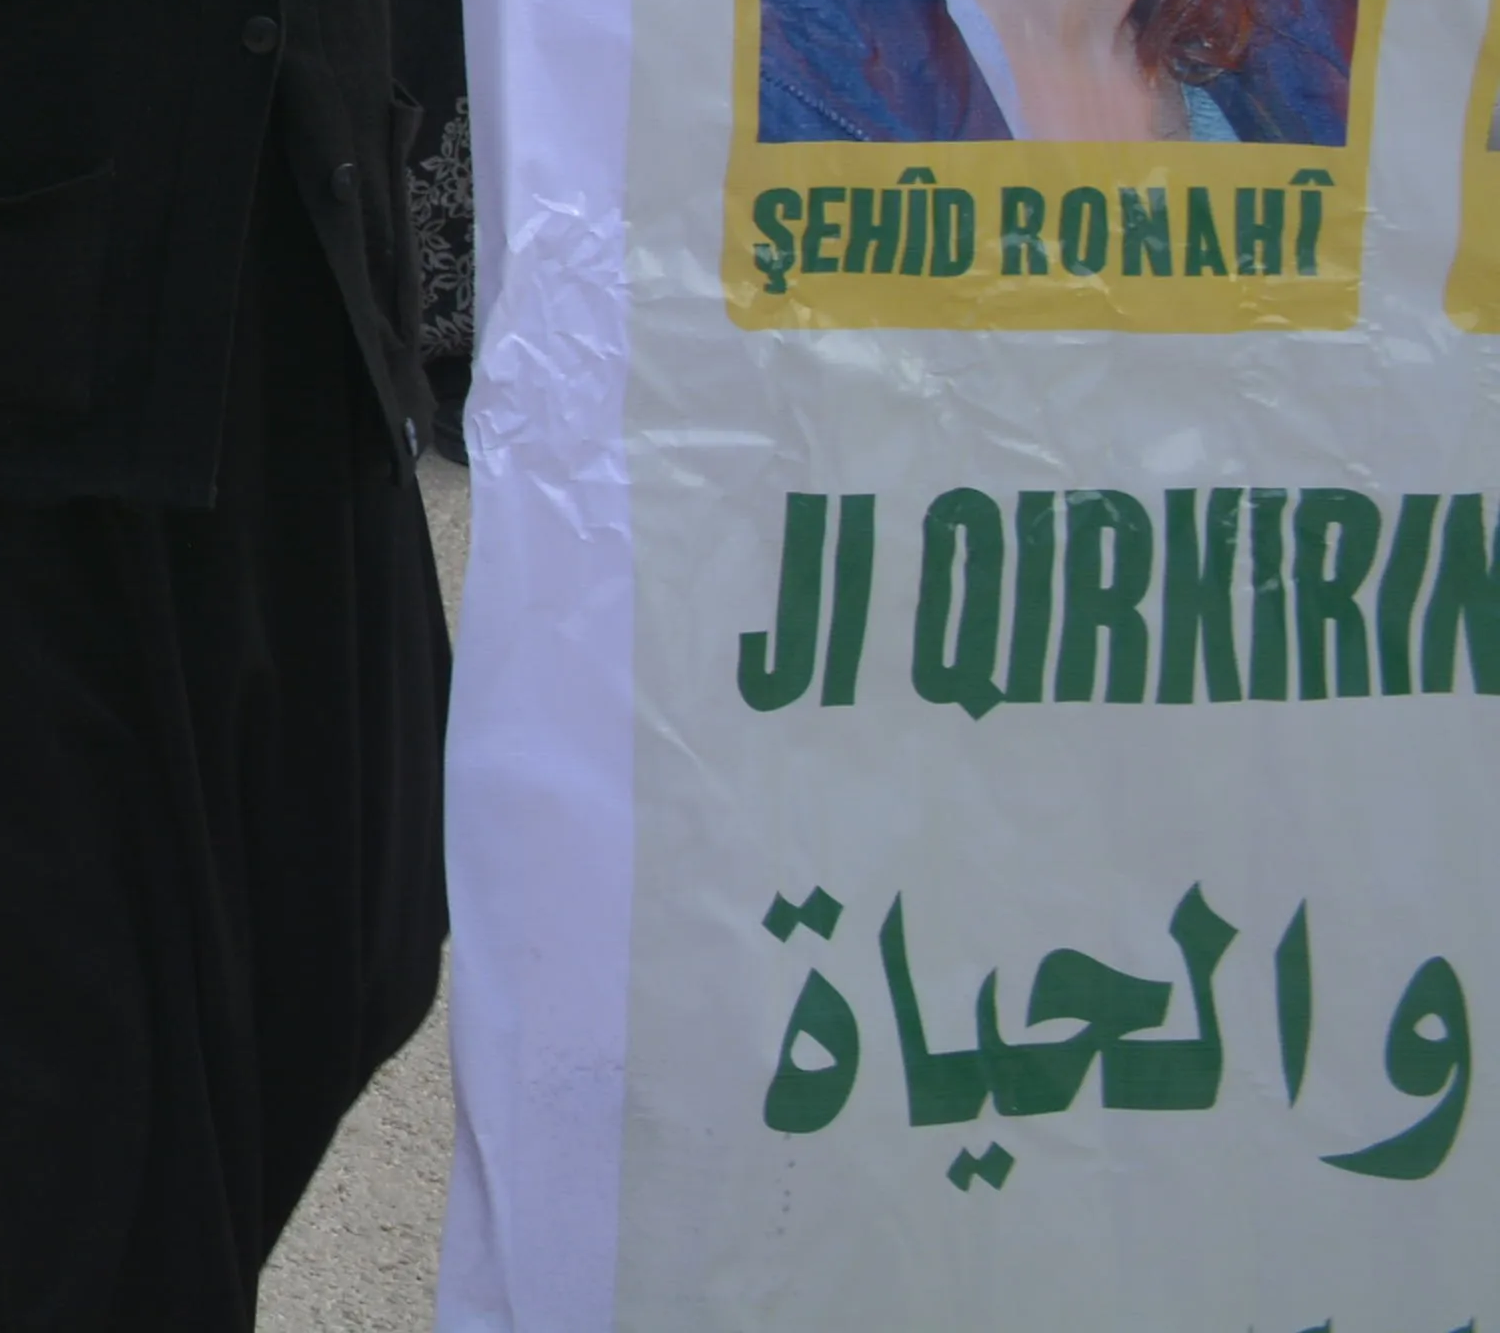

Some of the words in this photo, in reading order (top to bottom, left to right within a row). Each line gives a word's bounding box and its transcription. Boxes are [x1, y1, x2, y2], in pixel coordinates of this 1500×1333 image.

[752, 166, 976, 295] ŞEHÎD
[1001, 168, 1336, 277] RONAHÎ
[736, 491, 877, 712] JI
[760, 880, 1472, 1194] والحياة
